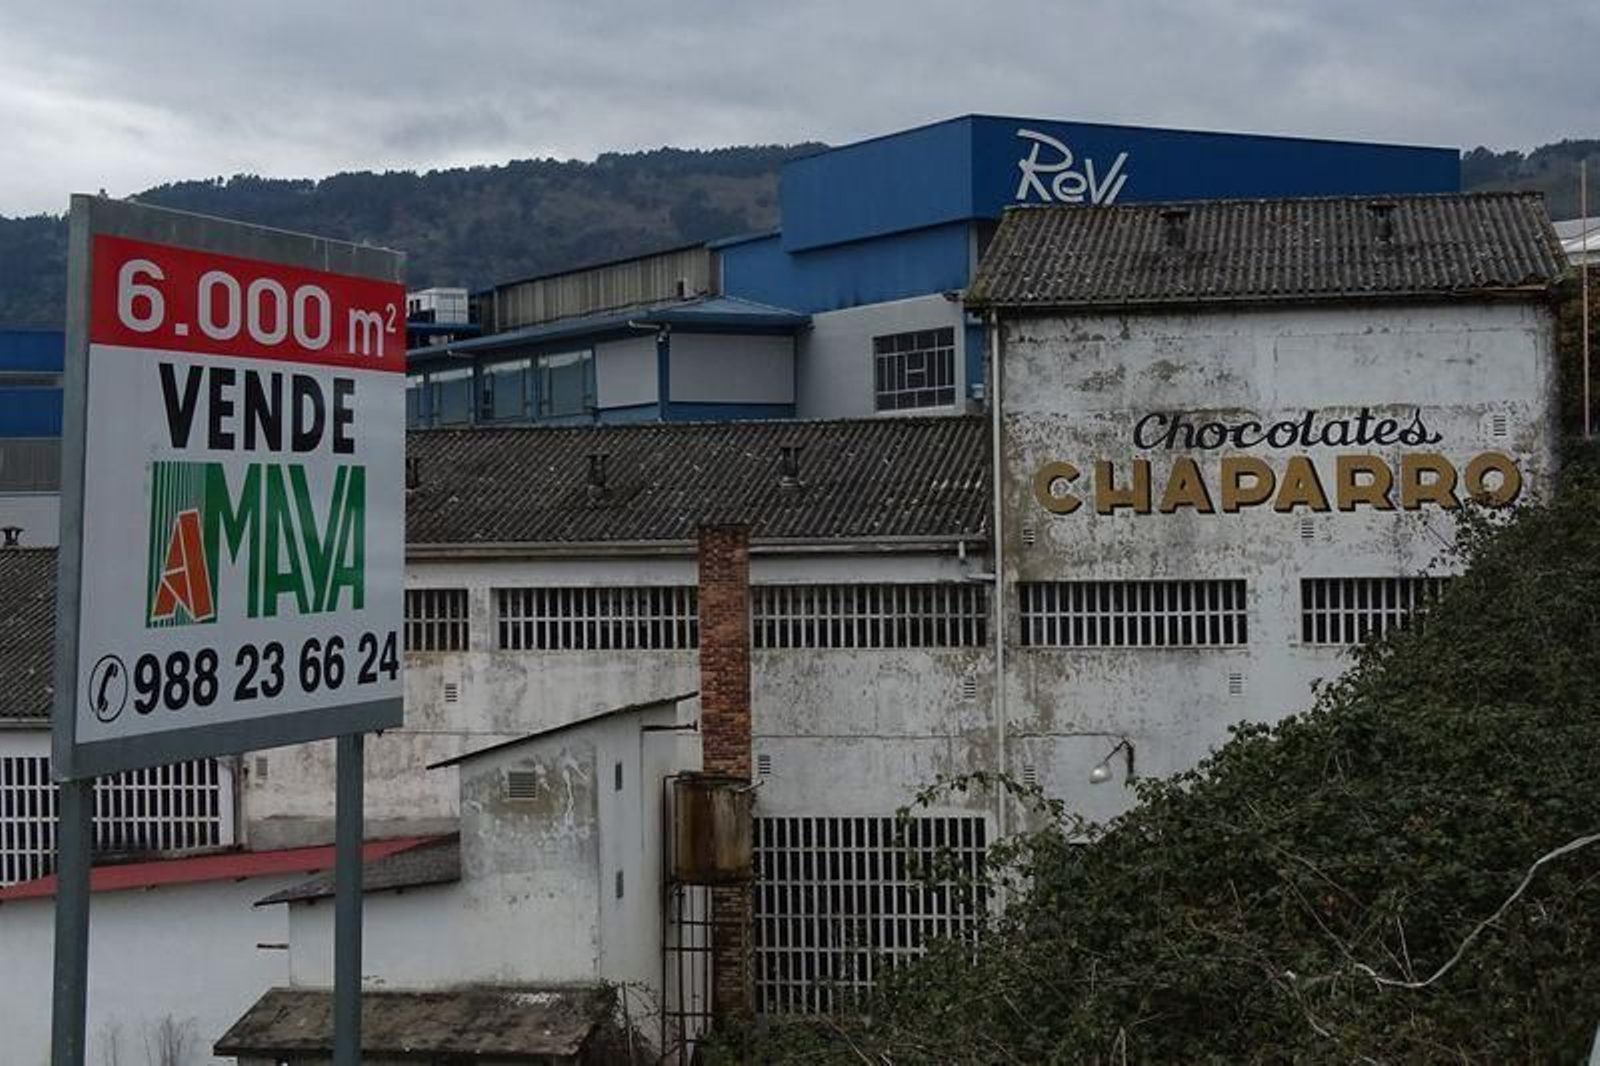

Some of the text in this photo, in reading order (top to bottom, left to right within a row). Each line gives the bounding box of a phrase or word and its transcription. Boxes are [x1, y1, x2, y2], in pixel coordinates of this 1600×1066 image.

[116, 258, 332, 351] 6.000
[158, 362, 355, 454] VENDE
[1133, 408, 1443, 450] Chocolates
[1033, 451, 1523, 514] CHAPARRO
[133, 631, 399, 715] 988 23 66 24
